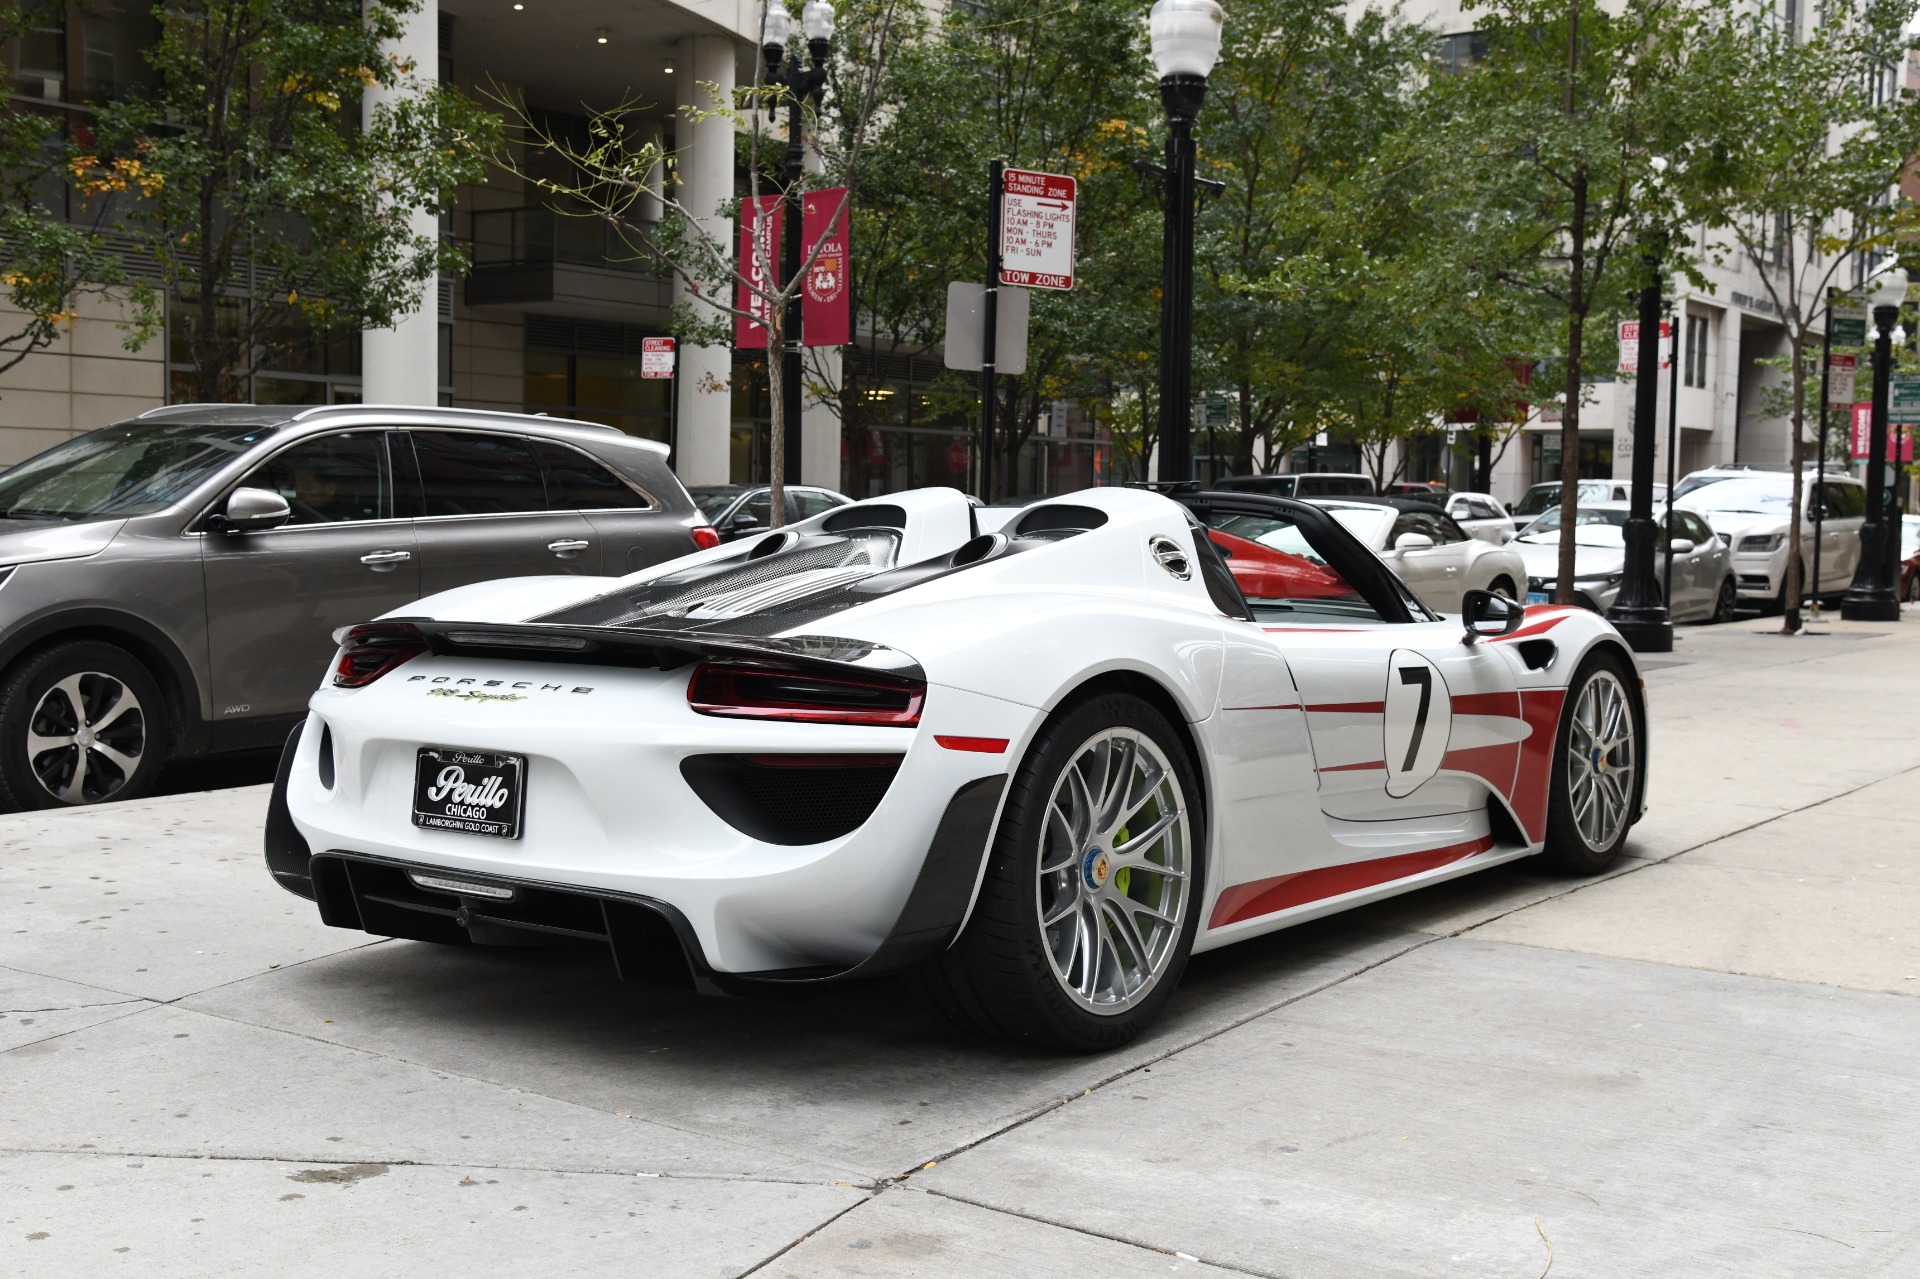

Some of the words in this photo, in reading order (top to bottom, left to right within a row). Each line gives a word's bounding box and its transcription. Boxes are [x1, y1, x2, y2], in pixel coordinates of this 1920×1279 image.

[1008, 172, 1016, 182] 15
[1018, 174, 1046, 186] MINUTE
[1008, 183, 1044, 195] STANDING
[1048, 188, 1067, 198] ZONE
[1008, 198, 1022, 208] USE
[1007, 208, 1043, 219] FLASHING
[1045, 213, 1070, 222] LIGHTS
[764, 216, 773, 258] CAMPUS
[1006, 226, 1023, 235] MON
[1032, 230, 1057, 240] THURS
[807, 242, 843, 255] LOLA
[1006, 246, 1018, 254] FRI
[1026, 248, 1042, 257] SUN
[1005, 270, 1030, 283] TOW
[1035, 274, 1066, 288] ZONE
[407, 675, 595, 695] PORSCHE
[223, 704, 250, 715] AWD
[1397, 665, 1432, 773] 7
[452, 751, 485, 764] Perillo
[427, 765, 509, 809] Perillo
[445, 803, 487, 820] CHICAGO
[426, 816, 464, 830] LAMBORGHINI
[464, 821, 480, 832] GOLD
[480, 823, 499, 834] COAST
